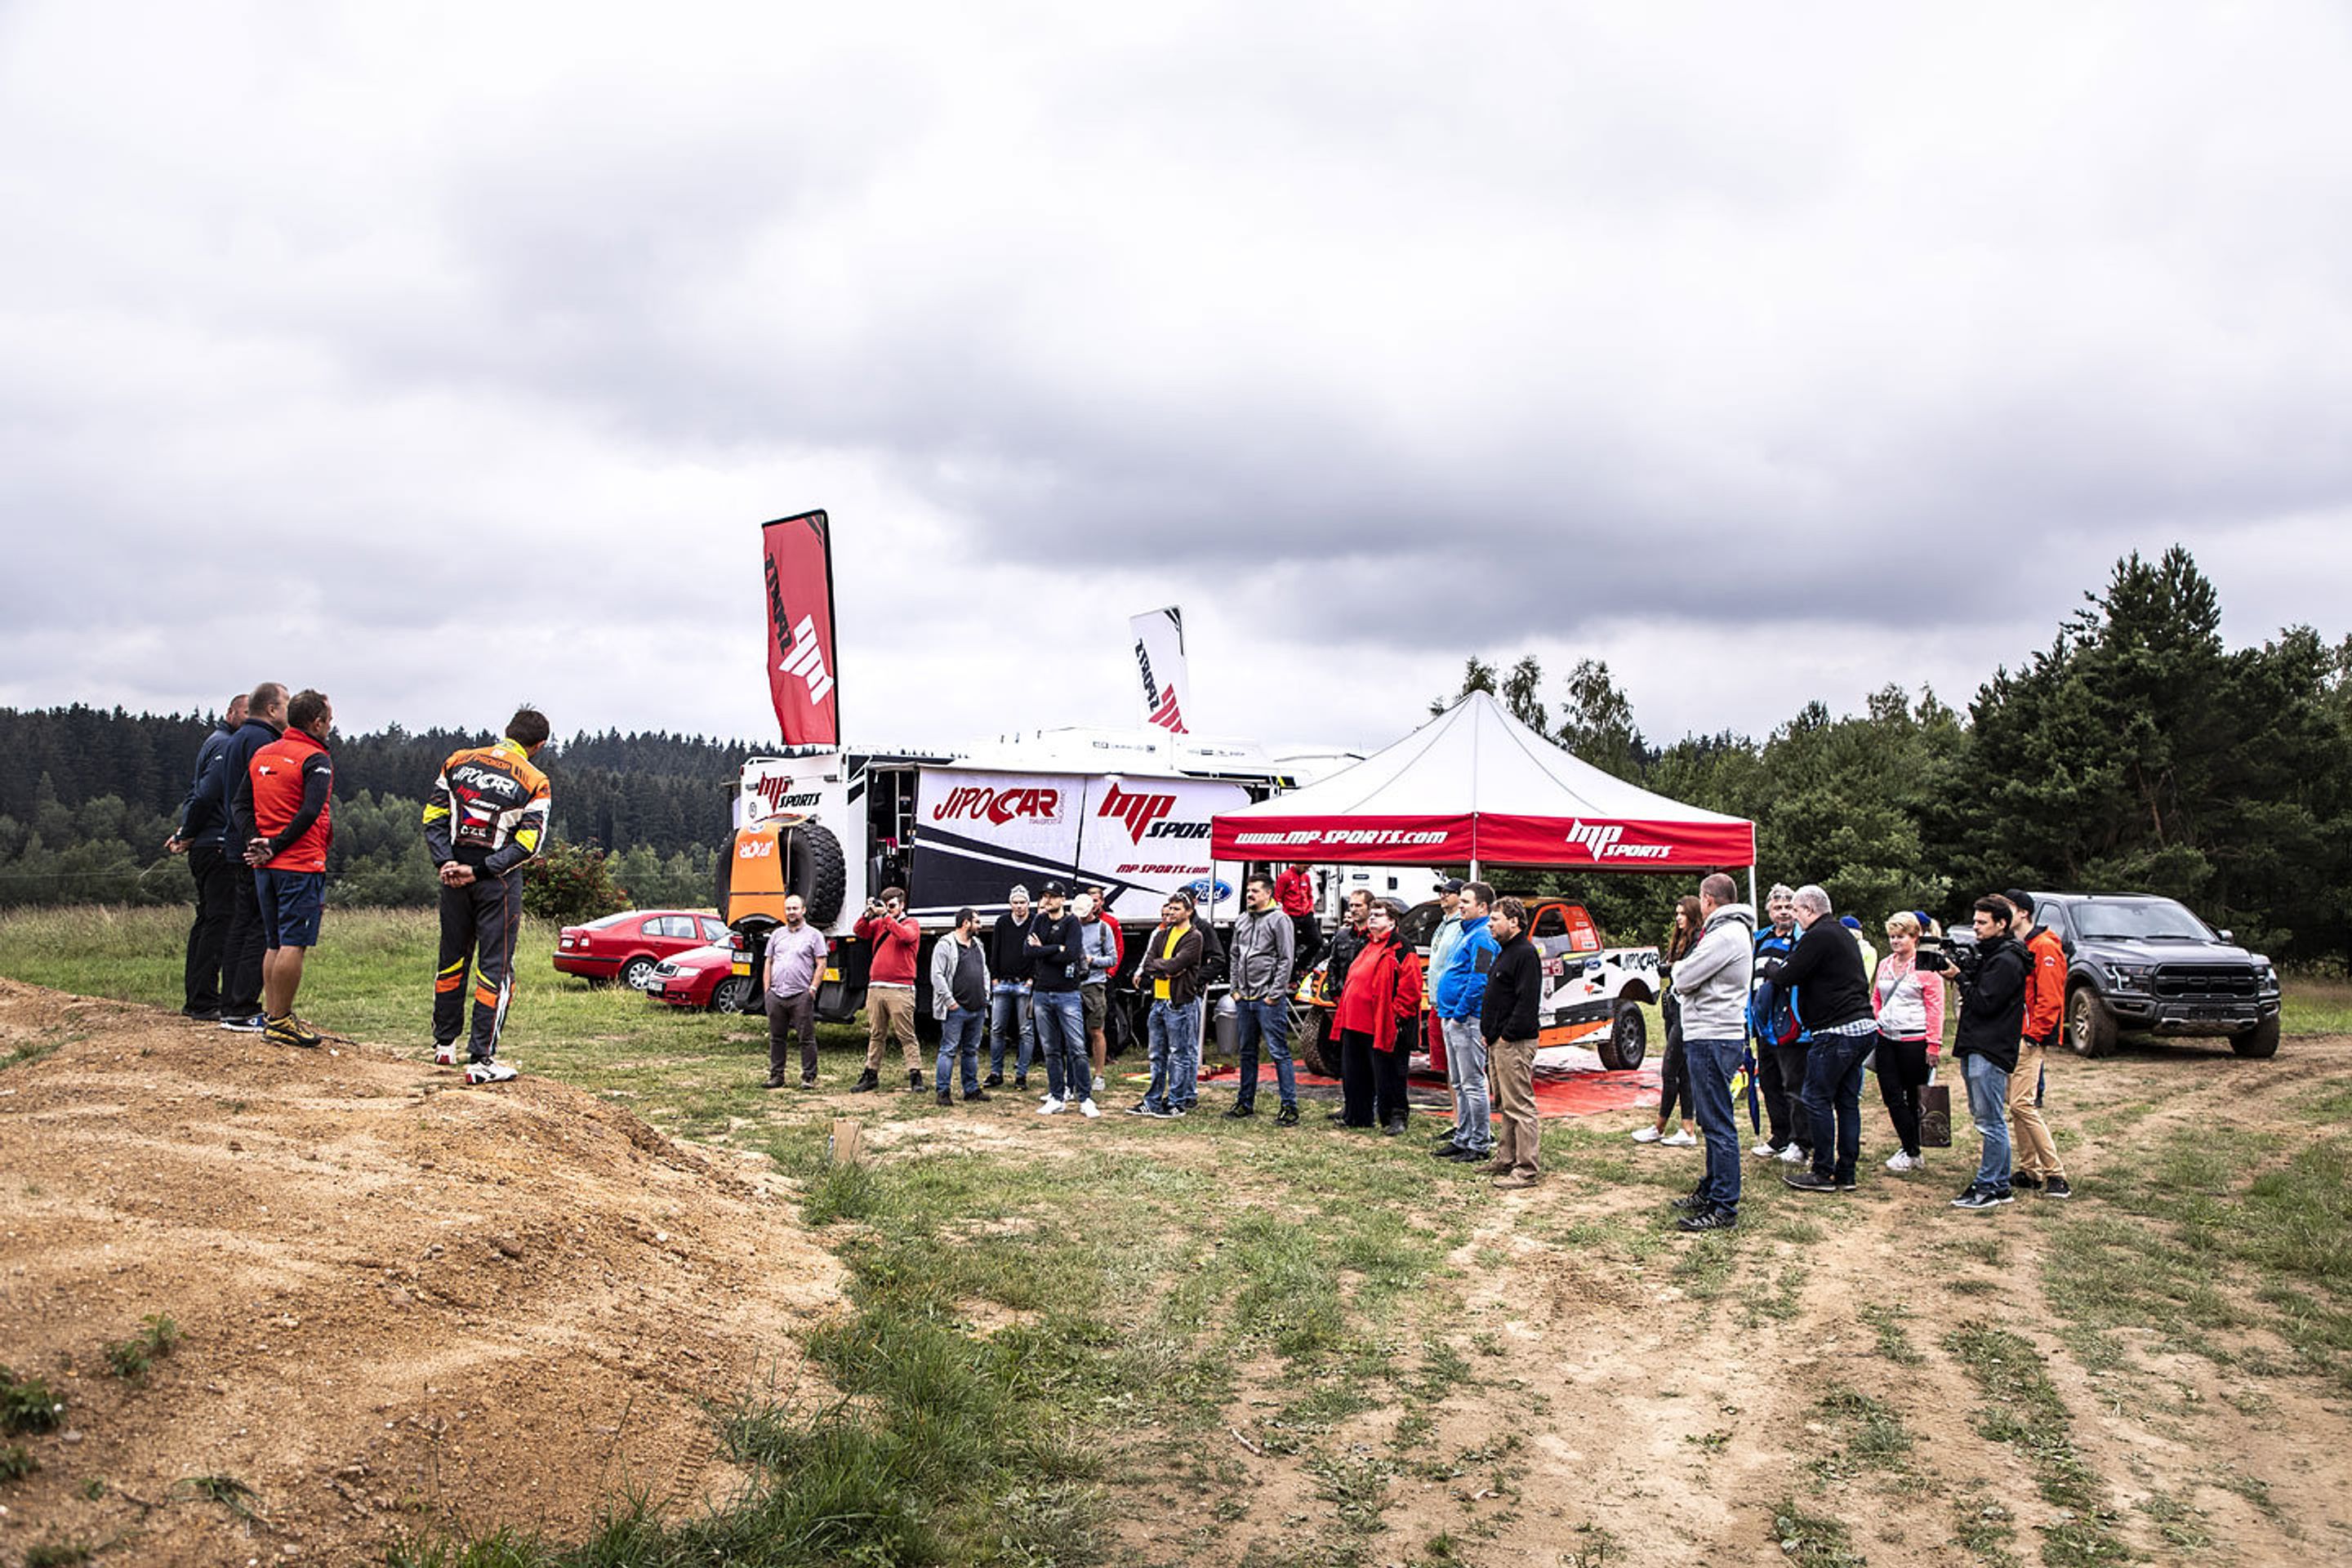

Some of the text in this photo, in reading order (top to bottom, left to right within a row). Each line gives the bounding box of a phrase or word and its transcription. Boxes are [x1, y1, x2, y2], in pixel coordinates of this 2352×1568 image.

[778, 792, 822, 808] SPORTS
[933, 787, 1058, 826] JIPOCAR
[1145, 822, 1211, 839] SPOR
[1602, 844, 1673, 858] SPORTS
